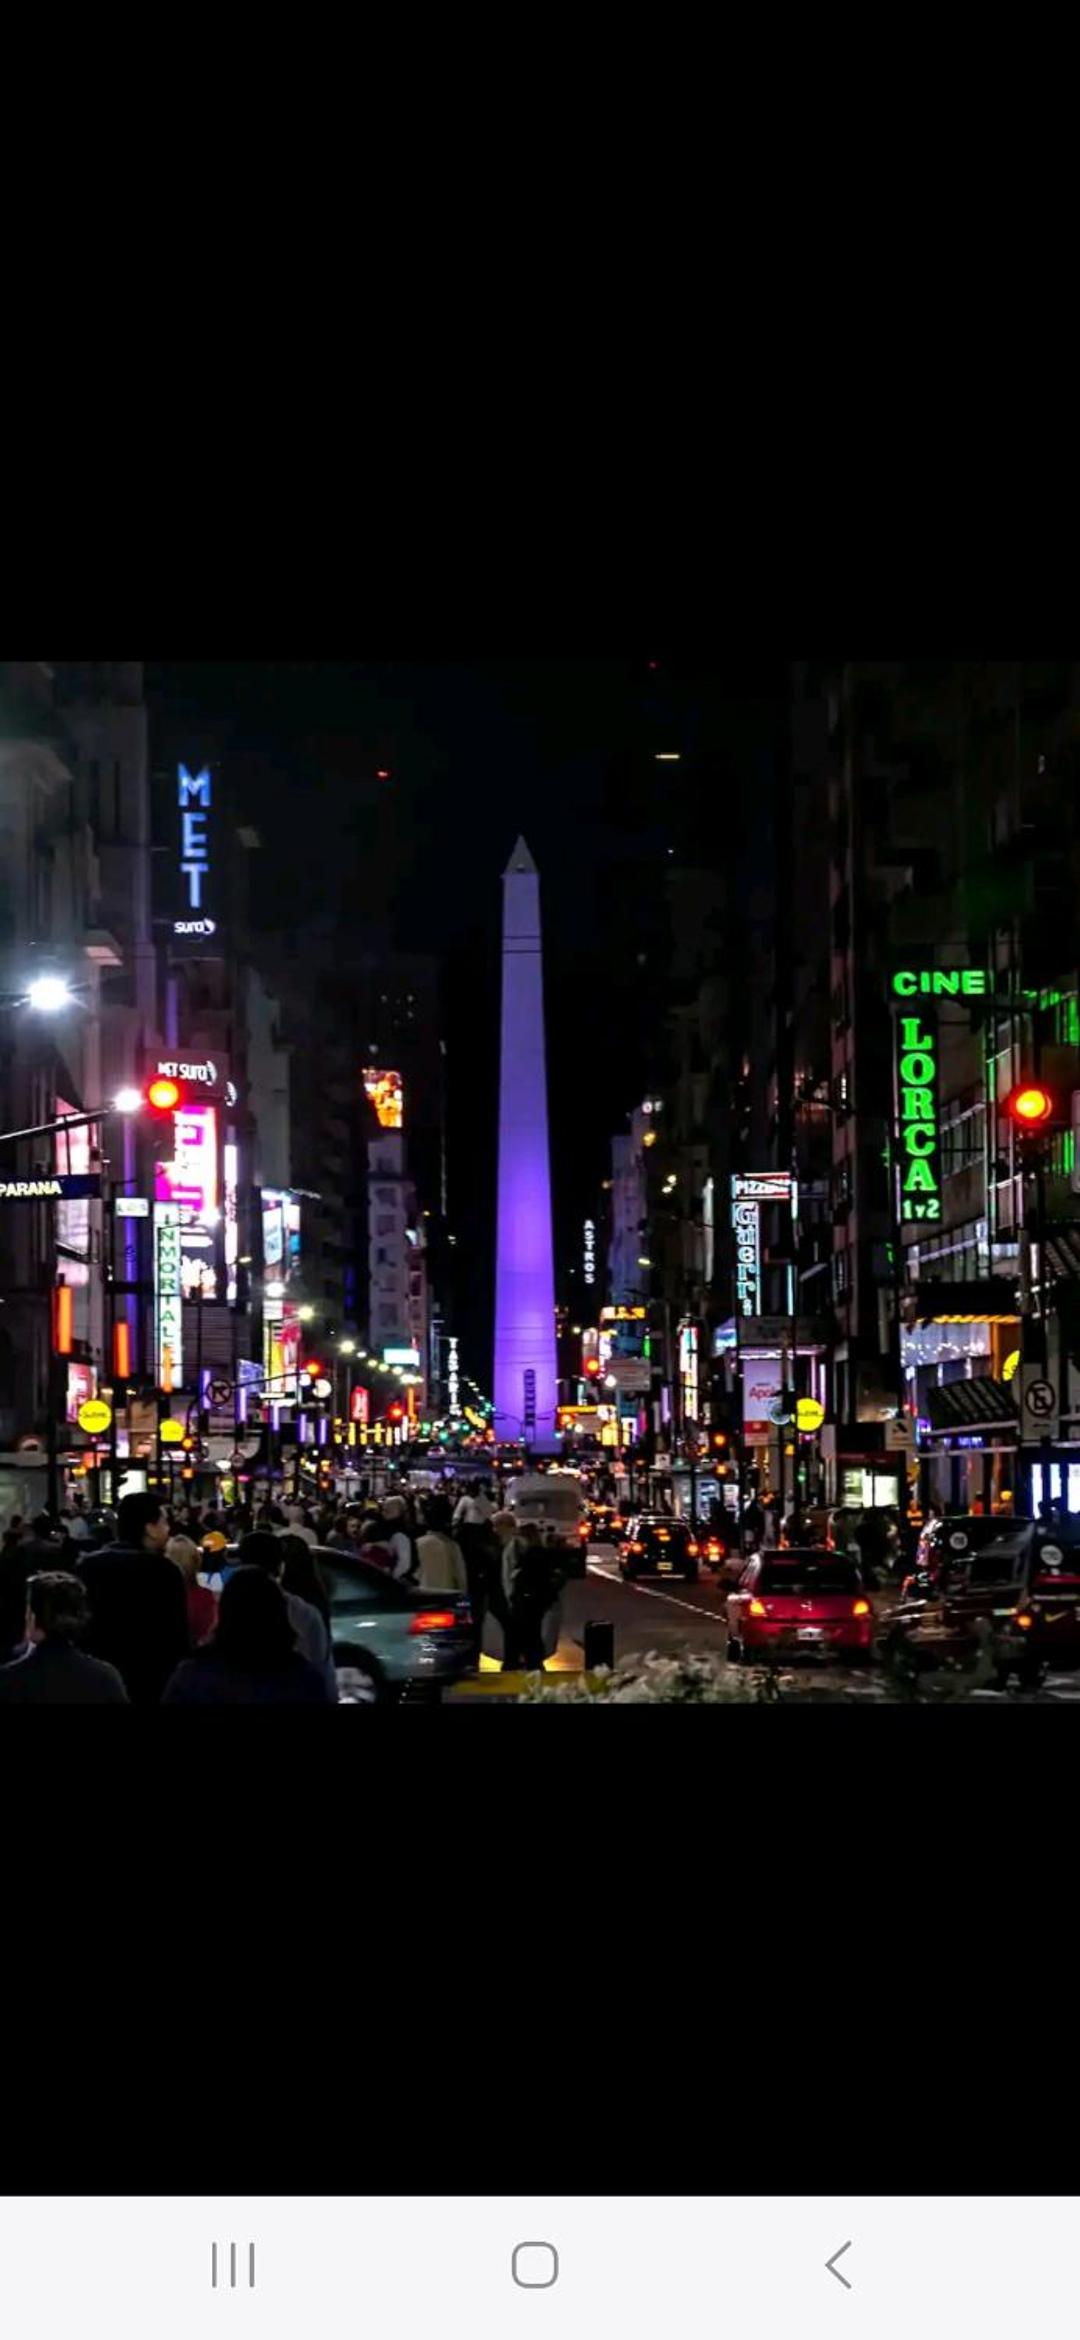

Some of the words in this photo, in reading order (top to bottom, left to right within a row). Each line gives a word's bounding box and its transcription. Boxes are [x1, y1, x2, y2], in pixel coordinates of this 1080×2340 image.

[177, 762, 211, 908] MET
[174, 920, 205, 935] sura
[893, 970, 985, 996] CINE
[900, 1017, 938, 1191] LORCA
[583, 1219, 595, 1284] ASTROS
